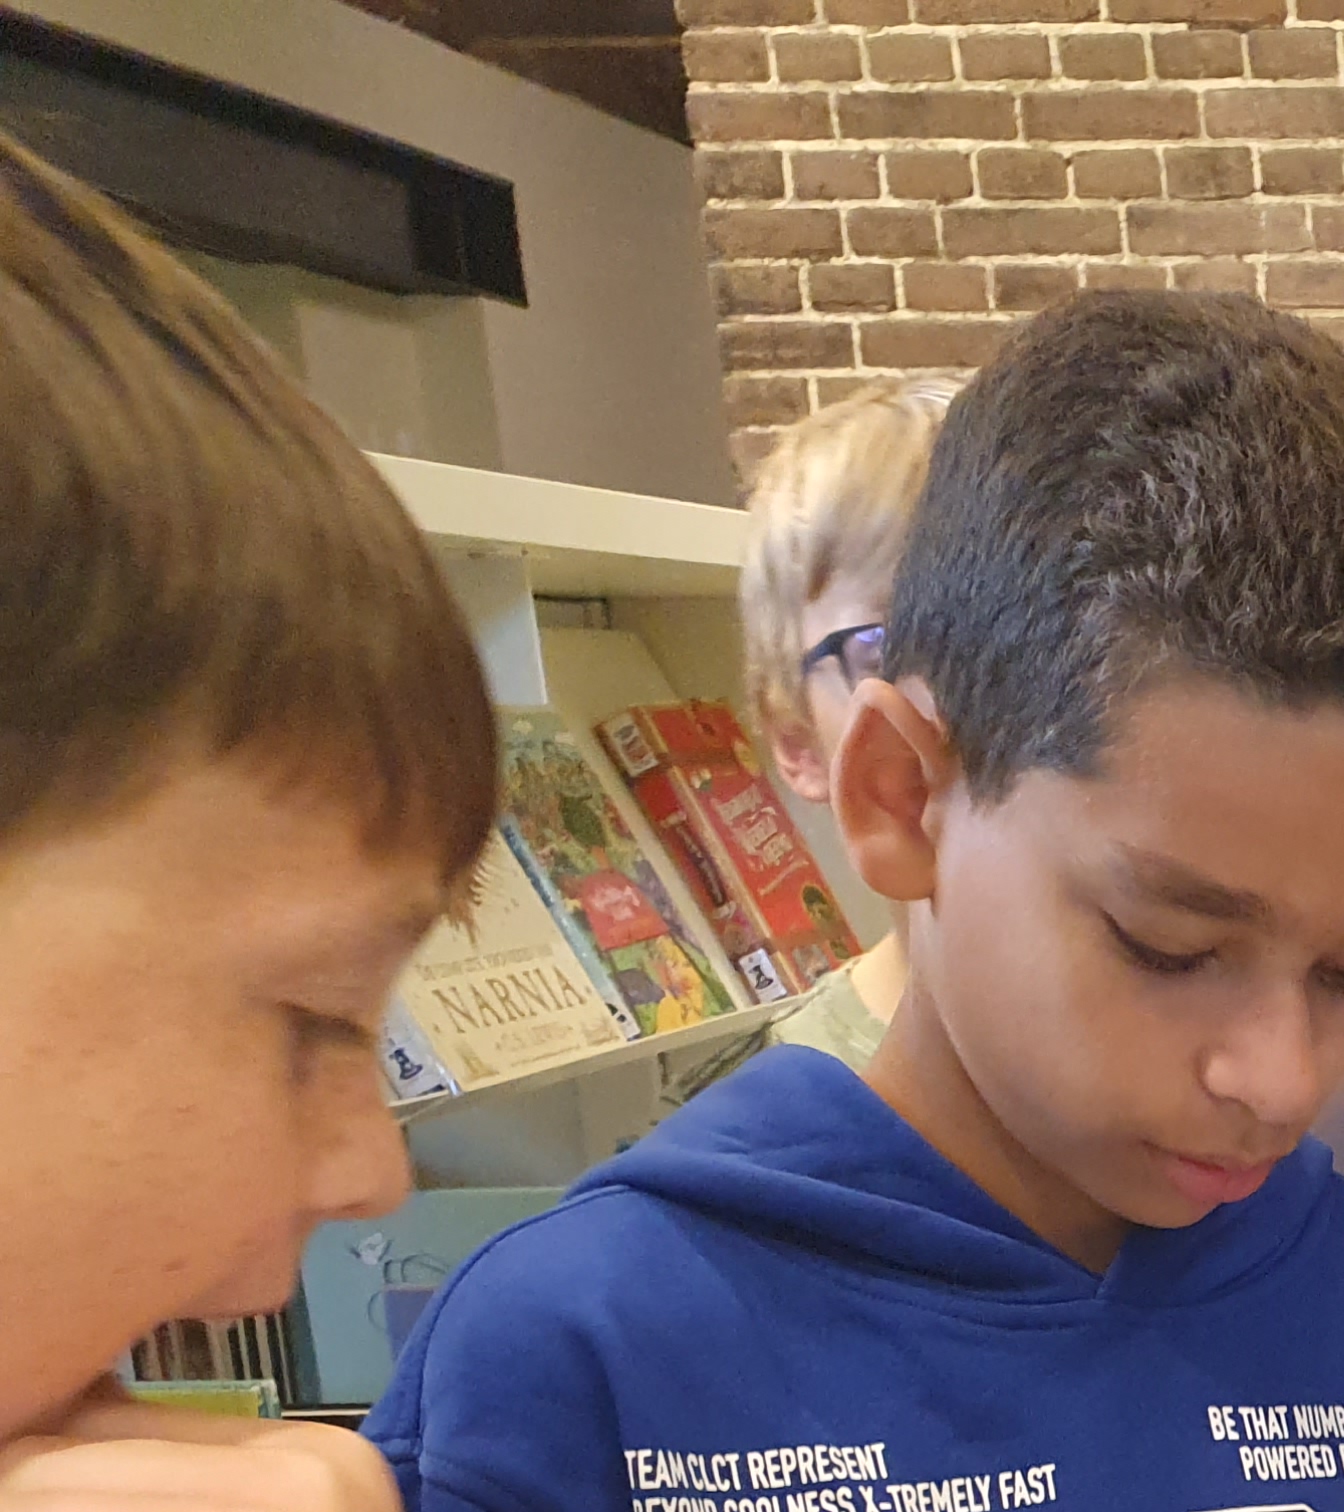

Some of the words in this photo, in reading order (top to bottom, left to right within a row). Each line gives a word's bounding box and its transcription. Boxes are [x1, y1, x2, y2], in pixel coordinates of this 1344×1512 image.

[432, 965, 588, 1034] NARNIA
[1207, 1405, 1239, 1441] BE
[1238, 1405, 1290, 1441] THAT
[624, 1448, 686, 1490] TEAM
[686, 1452, 741, 1493] CLCT
[749, 1442, 889, 1491] REPRESENT
[998, 1463, 1057, 1510] FAST
[1238, 1445, 1337, 1481] POWERED
